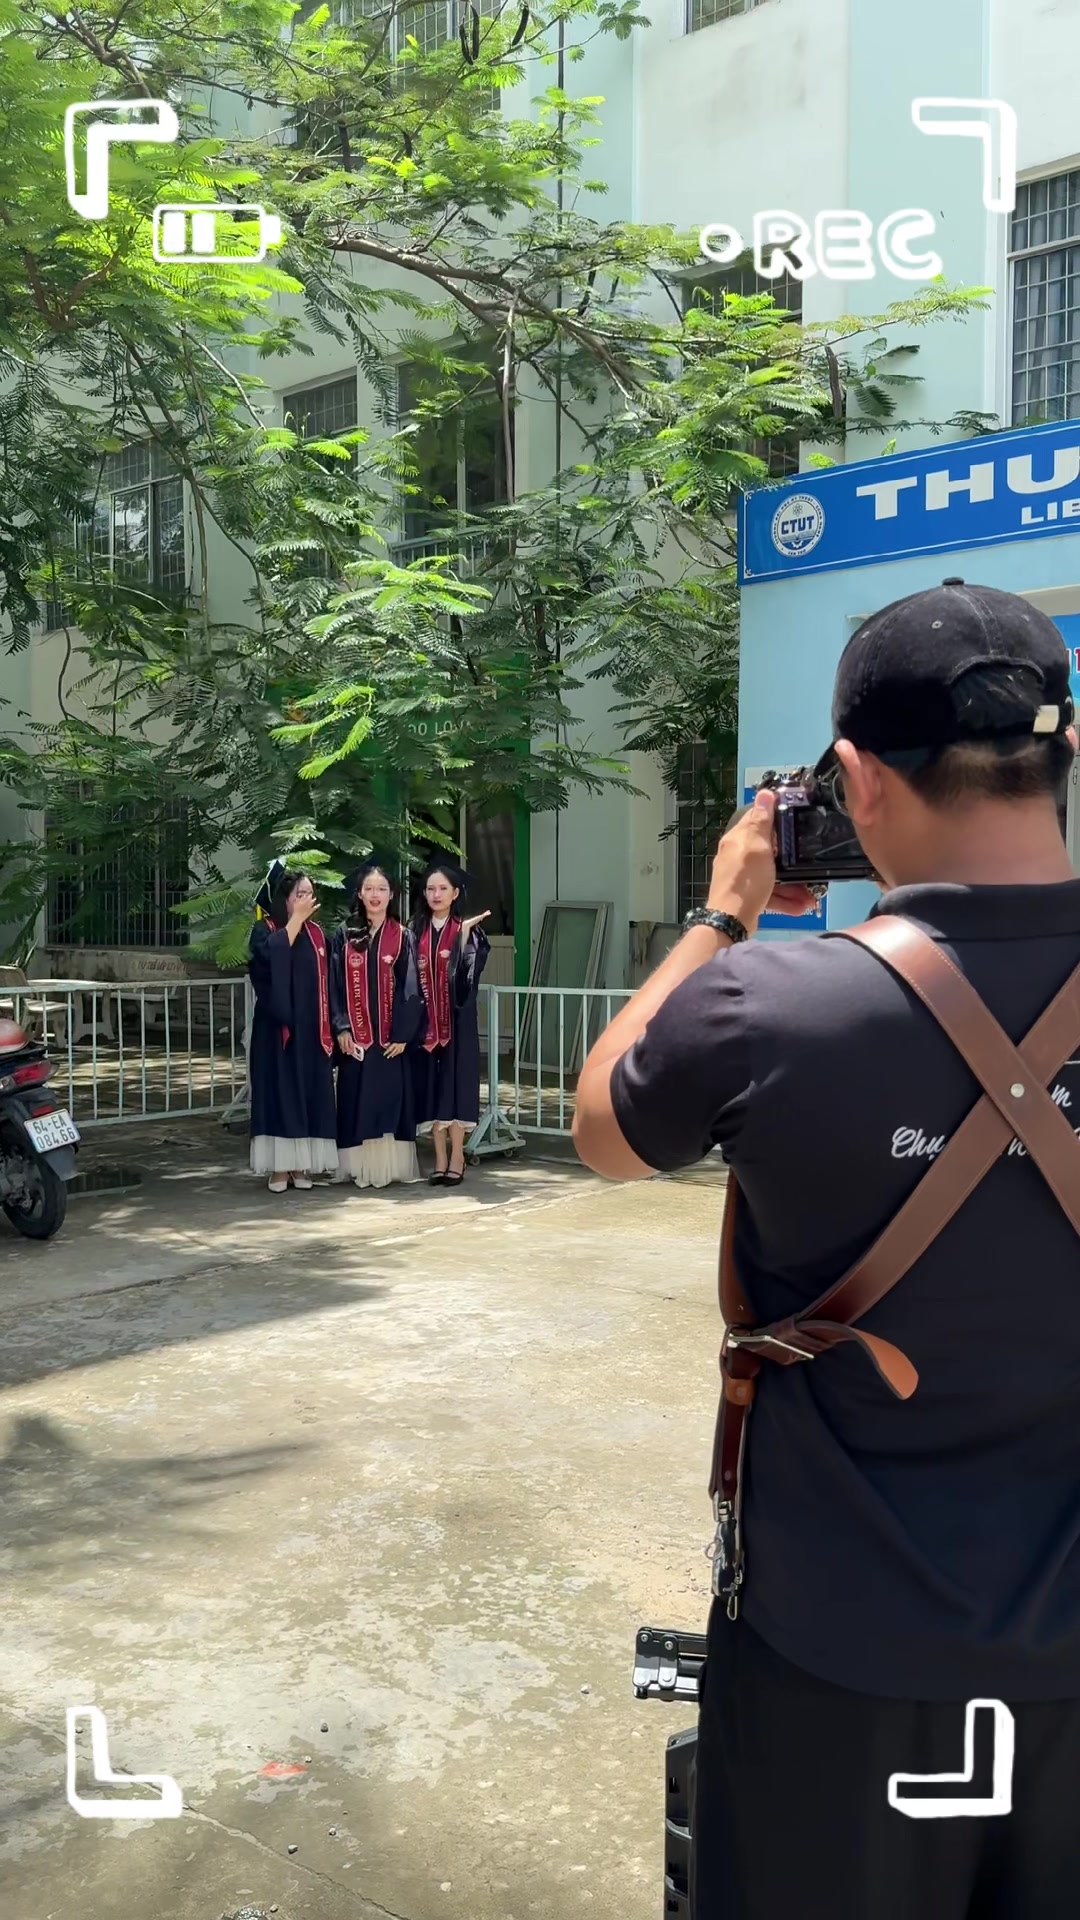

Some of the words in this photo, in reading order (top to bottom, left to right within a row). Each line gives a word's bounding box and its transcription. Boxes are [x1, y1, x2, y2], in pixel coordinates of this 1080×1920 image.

[781, 515, 815, 535] CTUT
[352, 970, 364, 1028] GRADUATION
[33, 1114, 67, 1134] 64-EA
[36, 1127, 76, 1149] 084.66
[891, 1126, 946, 1160] Chụ
